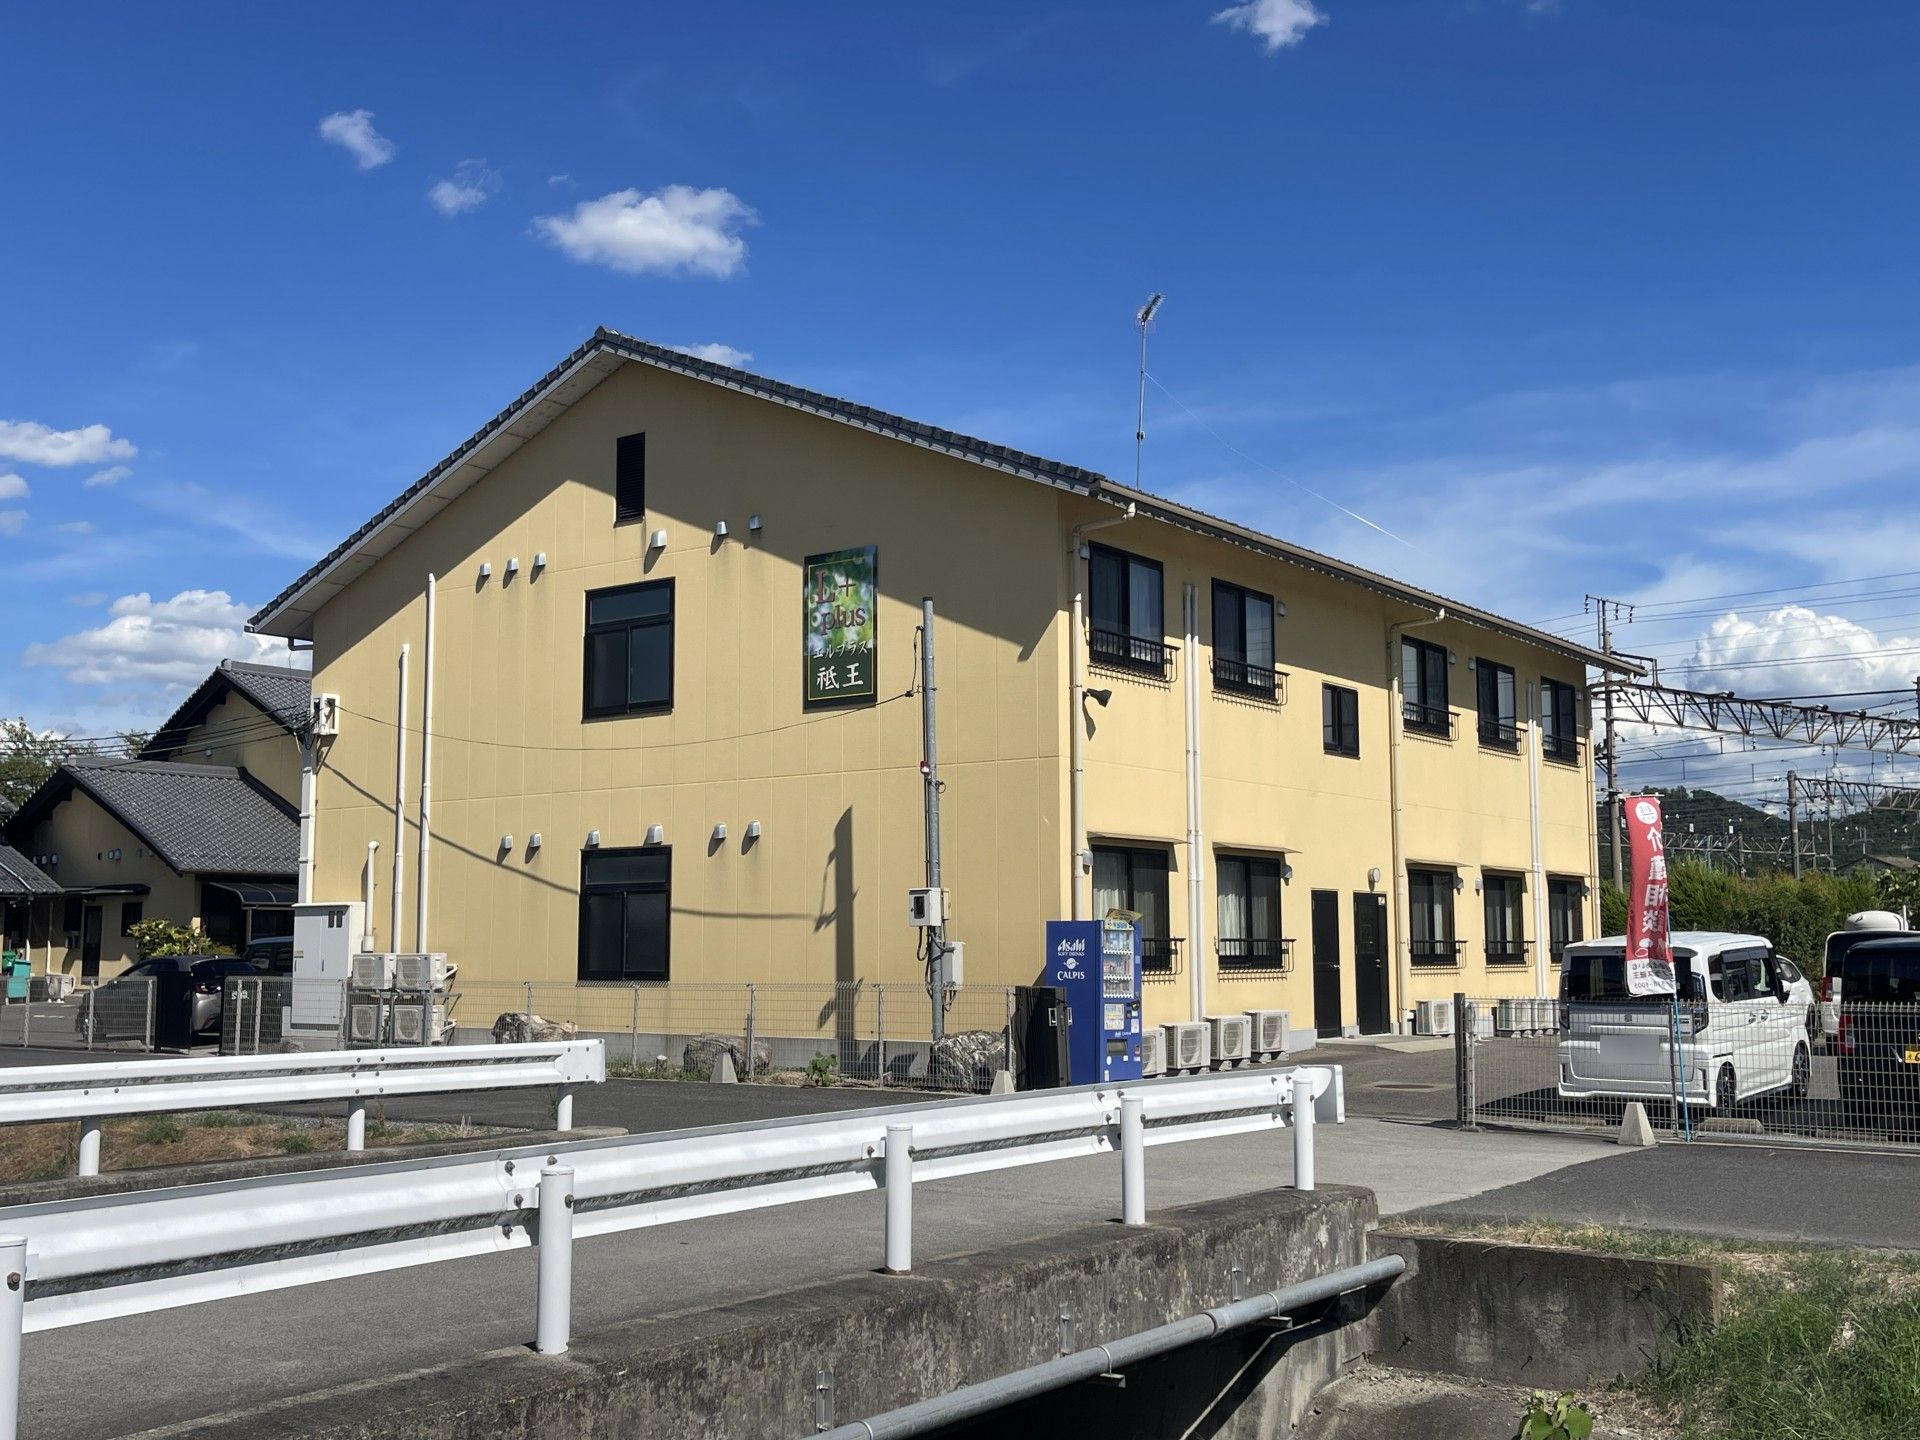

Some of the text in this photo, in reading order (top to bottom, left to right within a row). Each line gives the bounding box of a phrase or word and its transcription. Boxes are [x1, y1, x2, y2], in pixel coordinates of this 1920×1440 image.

[820, 604, 866, 636] plus
[813, 640, 868, 659] エルプラス
[1057, 938, 1086, 951] Asahi
[1057, 970, 1085, 981] CALPIS
